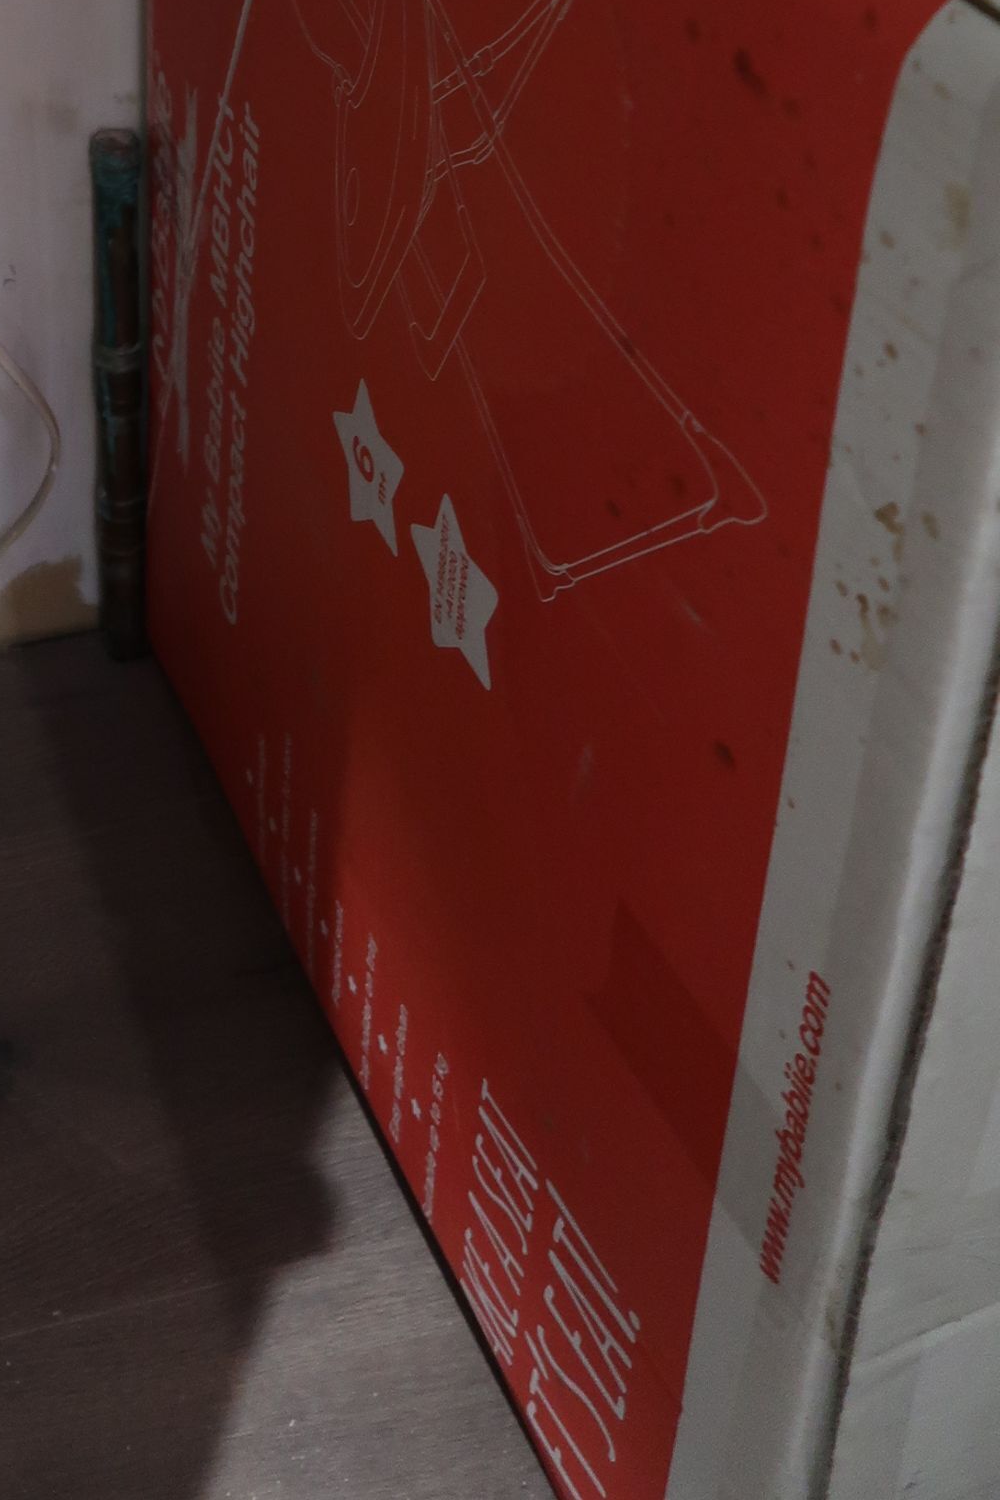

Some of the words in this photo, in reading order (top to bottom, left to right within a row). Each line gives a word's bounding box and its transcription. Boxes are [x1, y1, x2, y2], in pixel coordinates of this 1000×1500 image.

[227, 100, 263, 387] Highchair
[201, 315, 228, 482] Babiie
[352, 435, 375, 483] 6
[197, 487, 221, 569] My
[217, 390, 249, 626] Compact
[454, 553, 470, 641] approved
[364, 972, 375, 999] on
[365, 932, 379, 971] tray
[394, 1003, 409, 1056] clean
[432, 1053, 450, 1076] kg
[428, 1124, 441, 1153] up
[431, 1102, 443, 1125] to
[761, 969, 832, 1287] www.mybabiie.com
[471, 1077, 540, 1255] SEAT
[467, 1190, 525, 1296] A
[459, 1227, 520, 1365] AKE
[543, 1178, 642, 1421] EAT!
